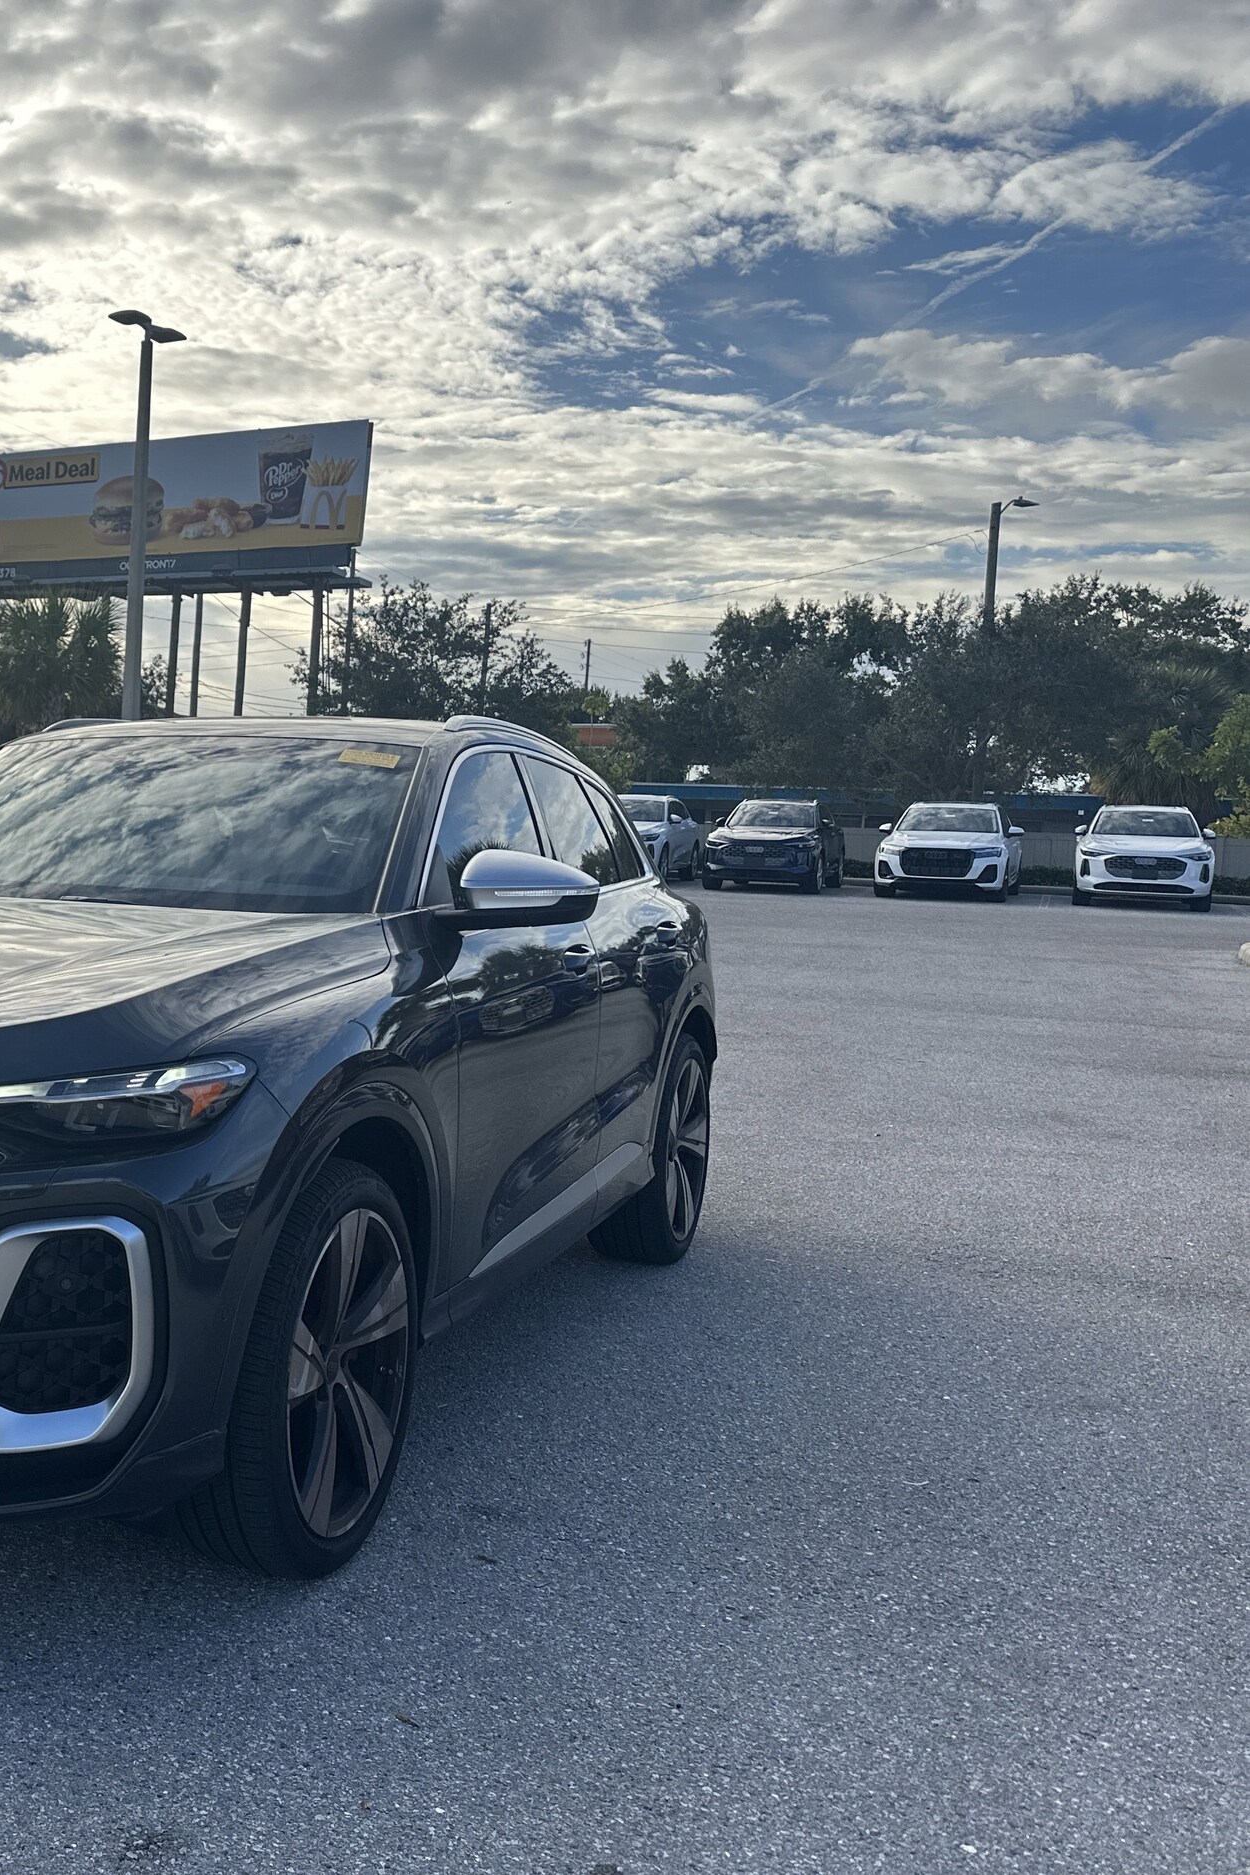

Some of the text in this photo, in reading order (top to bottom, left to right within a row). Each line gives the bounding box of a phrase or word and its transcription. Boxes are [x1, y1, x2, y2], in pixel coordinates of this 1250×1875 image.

[9, 462, 50, 482] Meal
[54, 458, 95, 479] Deal
[267, 465, 302, 487] Pepper
[278, 462, 293, 474] Dr
